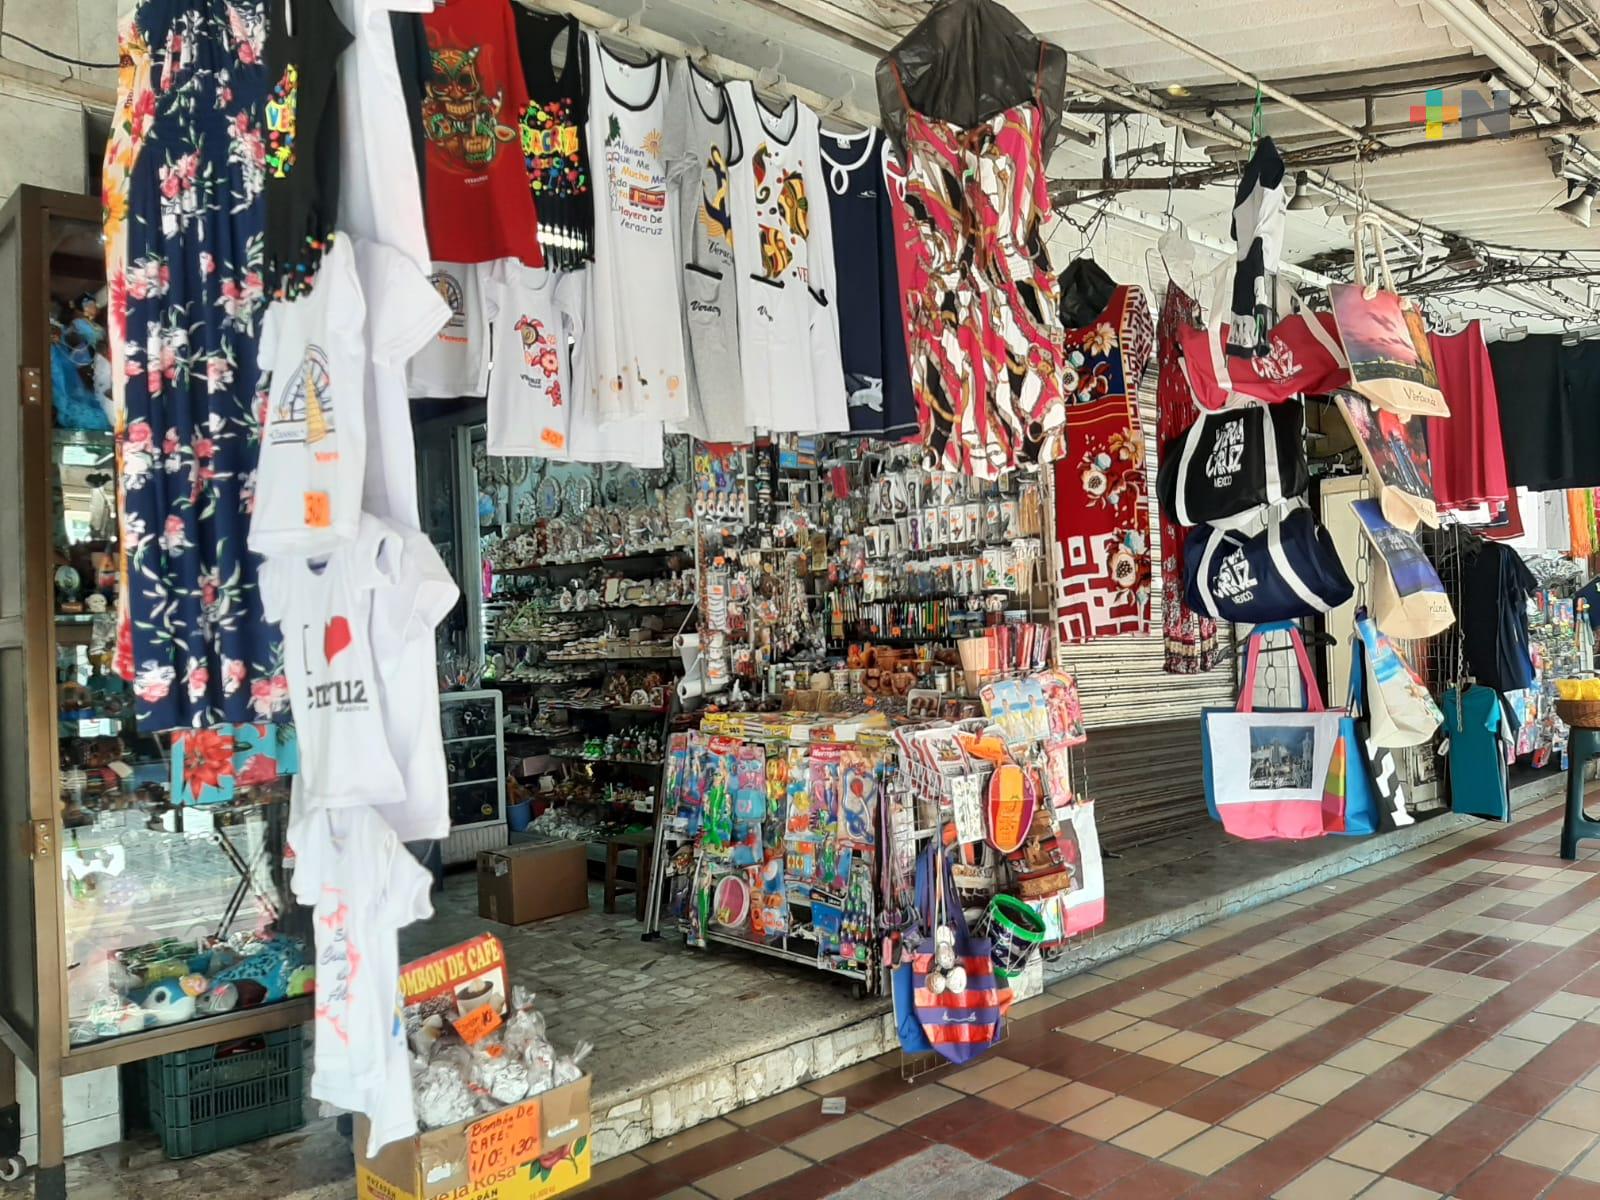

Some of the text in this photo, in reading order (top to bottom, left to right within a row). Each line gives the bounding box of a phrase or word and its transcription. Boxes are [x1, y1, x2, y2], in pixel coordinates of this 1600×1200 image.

[614, 140, 645, 157] Alguien
[636, 159, 650, 171] Me
[621, 166, 650, 183] Mucho
[650, 215, 663, 225] De
[446, 951, 467, 980] DE
[467, 938, 500, 972] CAFE
